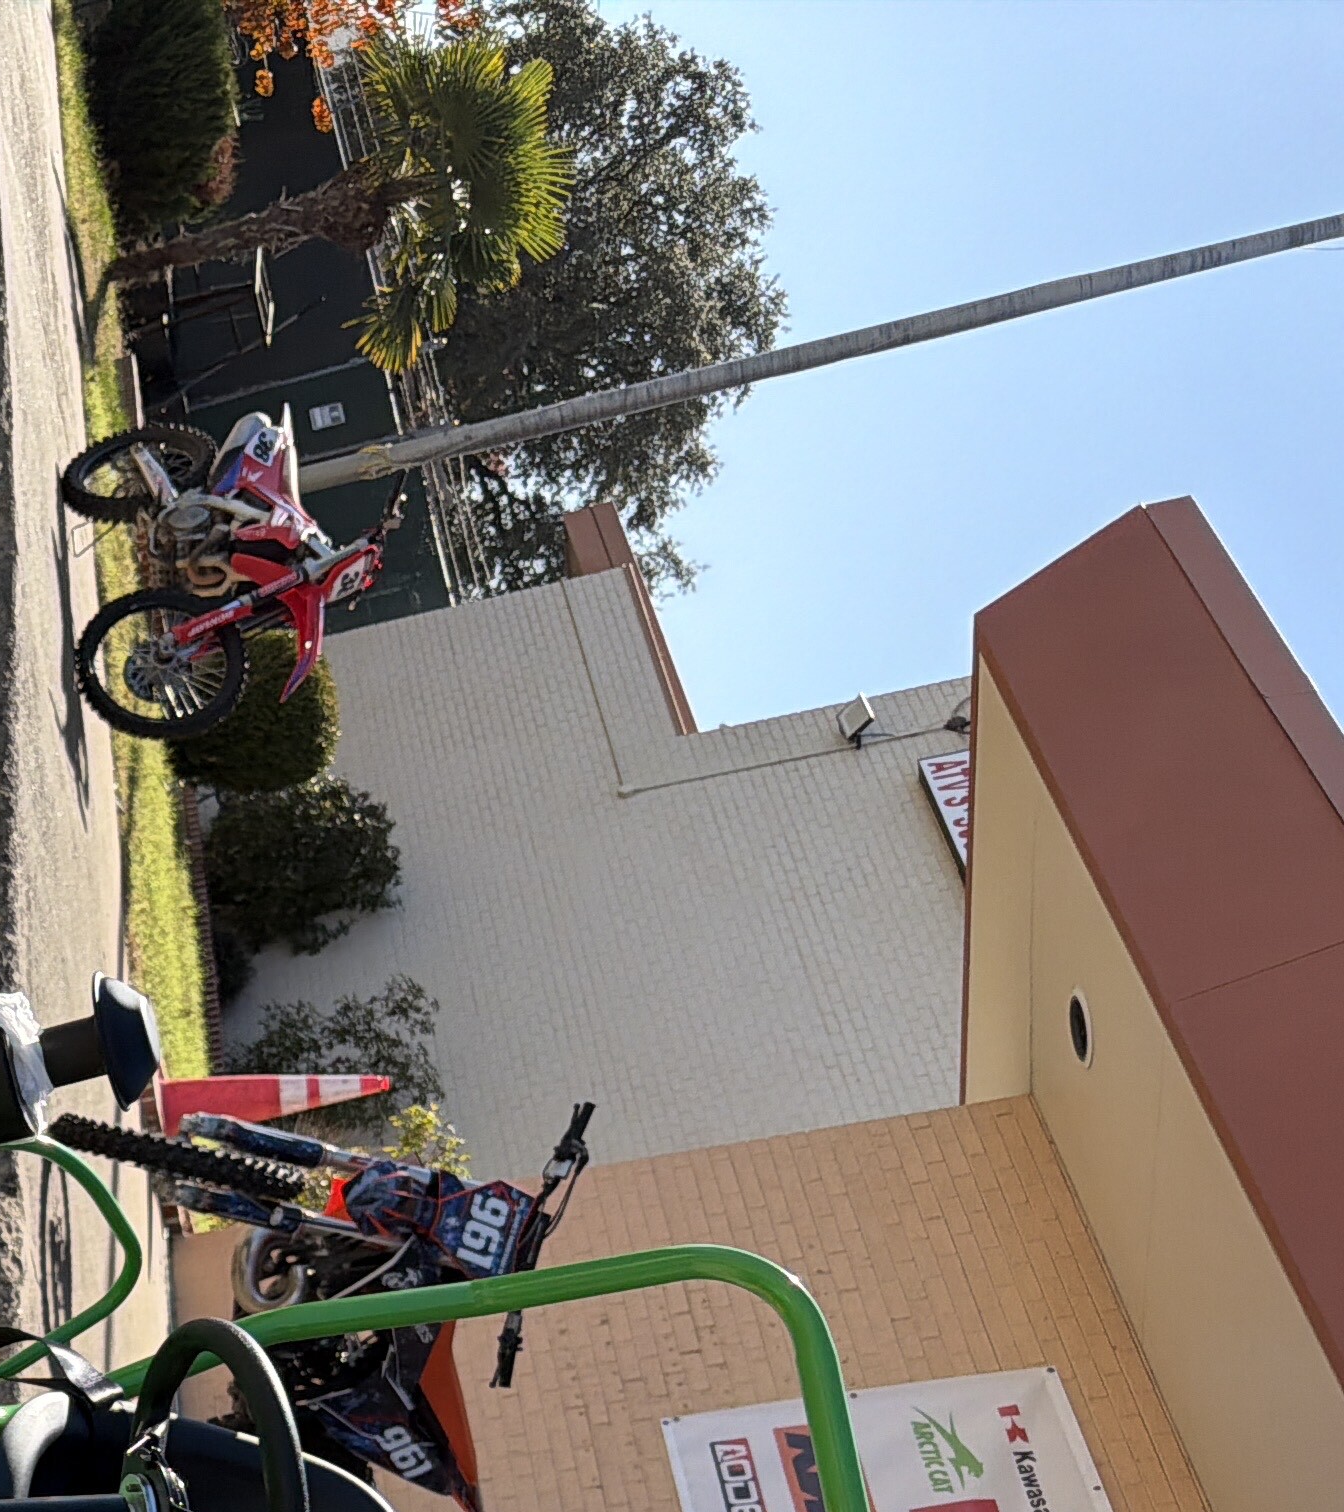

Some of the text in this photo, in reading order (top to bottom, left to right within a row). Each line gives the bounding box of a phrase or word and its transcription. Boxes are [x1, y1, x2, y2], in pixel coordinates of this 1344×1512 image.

[252, 431, 276, 464] 38
[456, 1192, 510, 1270] 961
[377, 1424, 433, 1480] 961
[911, 1421, 955, 1495] ARCTIC CAT
